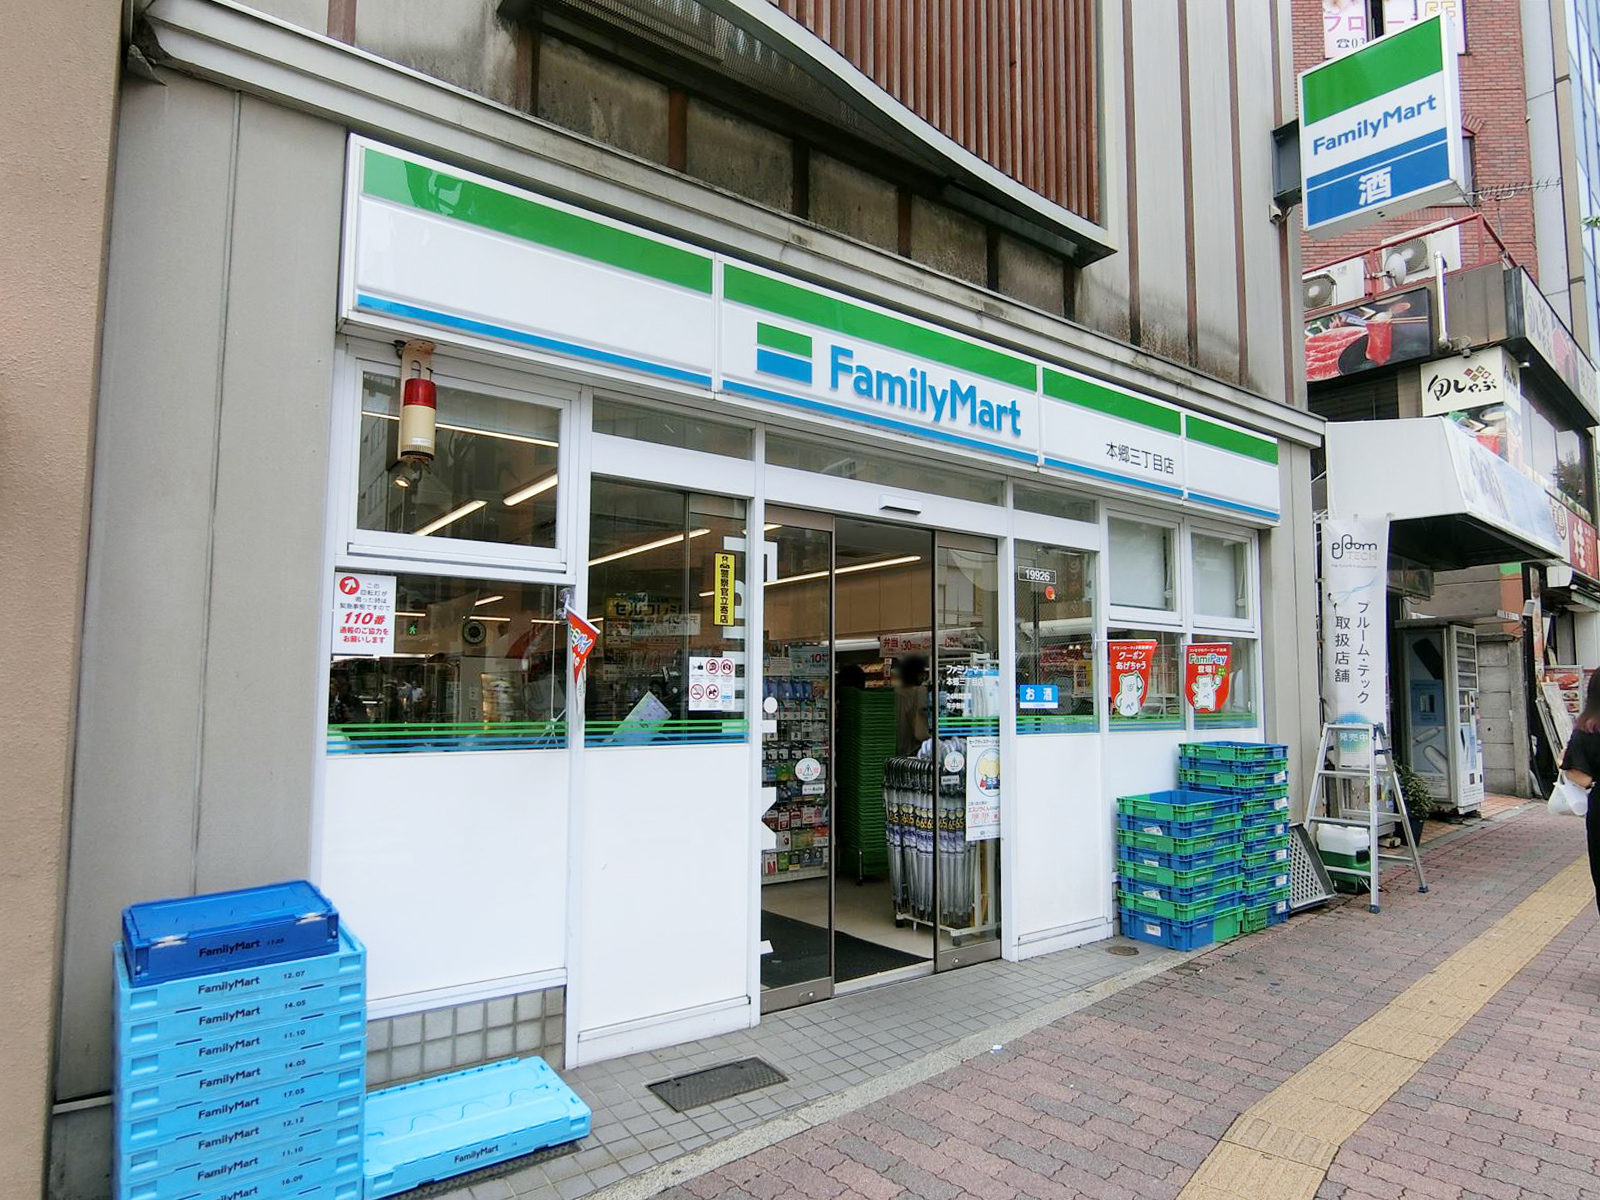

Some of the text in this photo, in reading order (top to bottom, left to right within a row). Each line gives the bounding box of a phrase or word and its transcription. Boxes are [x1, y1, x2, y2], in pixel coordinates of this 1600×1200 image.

[1312, 94, 1437, 156] FamilyMart
[1358, 166, 1392, 206] 酒
[829, 344, 1021, 438] FamilyMart
[1427, 374, 1497, 401] 旬しゃぶ
[1105, 441, 1175, 475] 本郷三丁目店
[1024, 569, 1051, 582] 19926
[344, 611, 387, 625] 110番
[340, 626, 389, 635] 通報のご協力を
[343, 635, 385, 643] お願いします
[1118, 650, 1146, 660] クーポン
[1188, 653, 1228, 665] FamiPay
[1334, 615, 1351, 684] 取扱店舗
[1115, 661, 1147, 670] あげちゃう
[1025, 687, 1053, 701] お酒
[199, 939, 261, 958] FamilyMart
[198, 976, 260, 994] FamilyMart
[198, 1005, 261, 1026] FamilyMart
[198, 1036, 261, 1057] FamilyMart
[199, 1067, 261, 1089] FamilyMart
[198, 1096, 260, 1120] FamilyMart
[198, 1126, 259, 1150] FamilyMart
[454, 1144, 499, 1163] FamilyMart
[197, 1156, 259, 1181] FamilyMart
[216, 1186, 259, 1200] ilyMart
